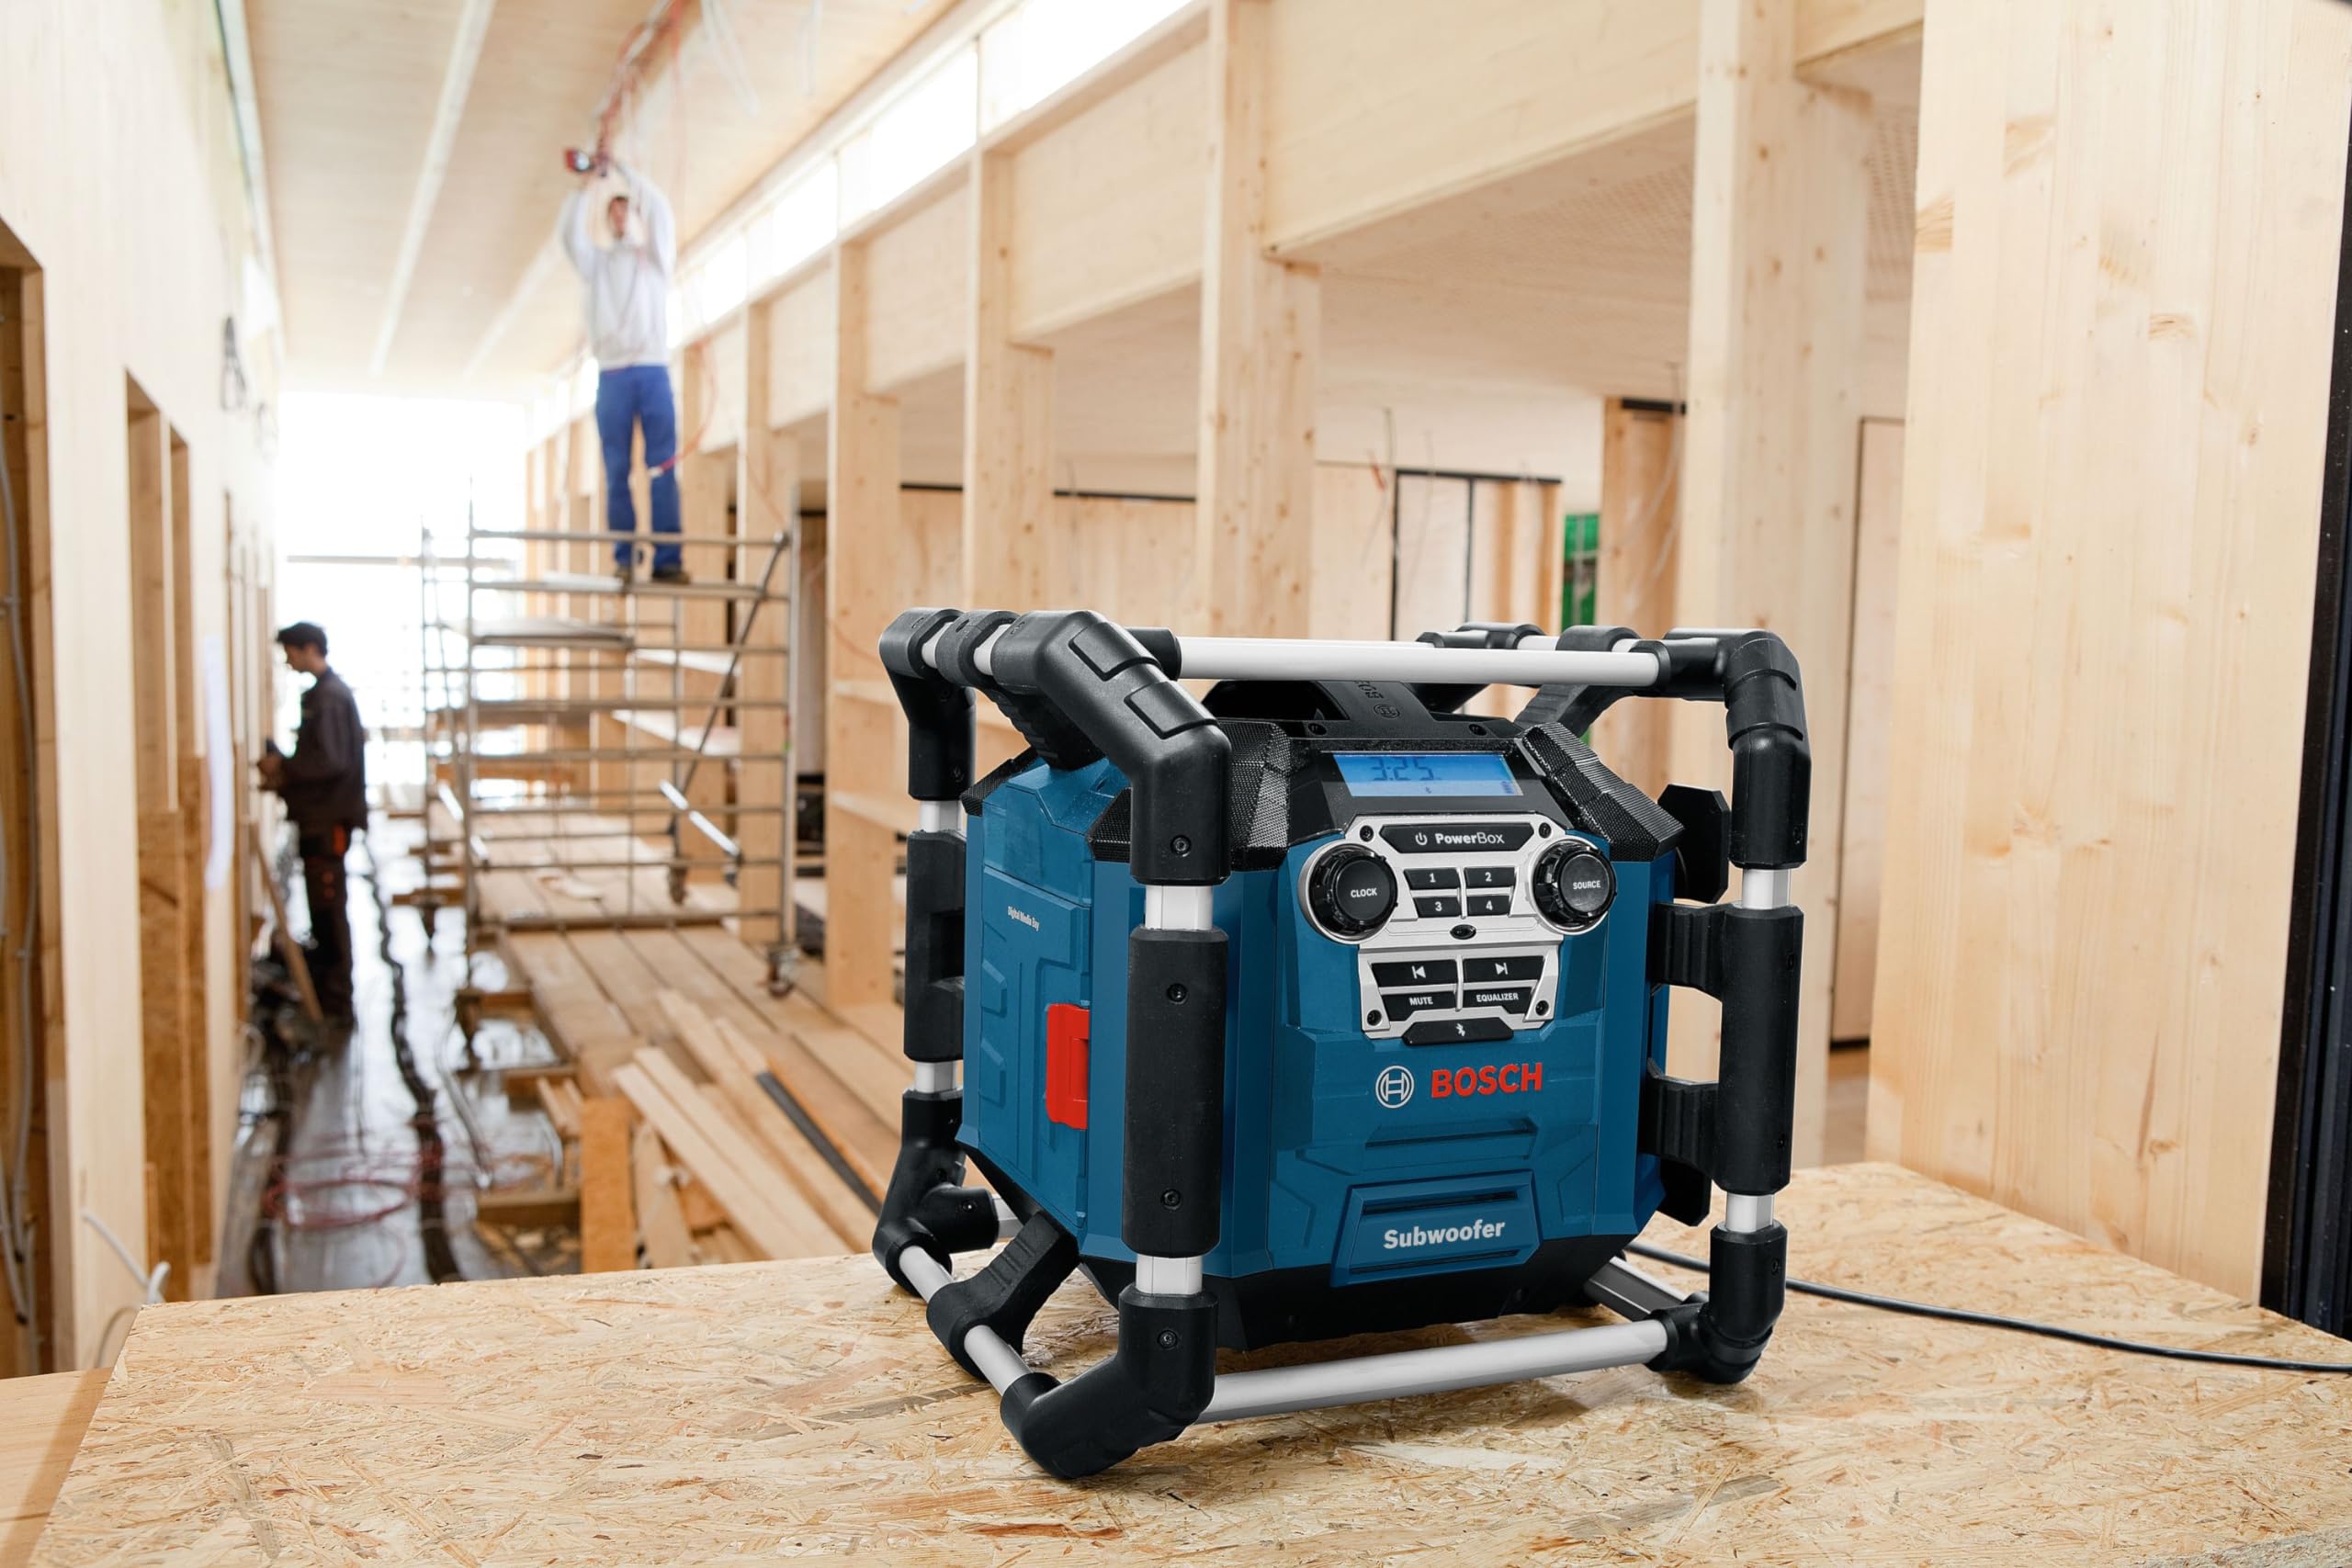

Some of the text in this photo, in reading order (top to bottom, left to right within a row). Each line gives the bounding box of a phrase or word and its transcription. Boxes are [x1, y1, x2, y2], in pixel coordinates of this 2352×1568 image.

[1434, 831, 1505, 844] PowerBox
[1429, 873, 1436, 884] 1
[1485, 871, 1492, 883] 2
[1572, 879, 1601, 890] SOURCE
[1350, 887, 1378, 898] CLOCK
[1434, 900, 1442, 912] 3
[1486, 900, 1493, 911] 4
[1007, 905, 1021, 919] Digital
[1020, 910, 1032, 927] Media
[1408, 996, 1434, 1006] MUTE
[1476, 992, 1520, 1003] EQUALIZER
[1430, 1062, 1544, 1099] BOSCH
[1383, 1218, 1506, 1249] Subwoofer
